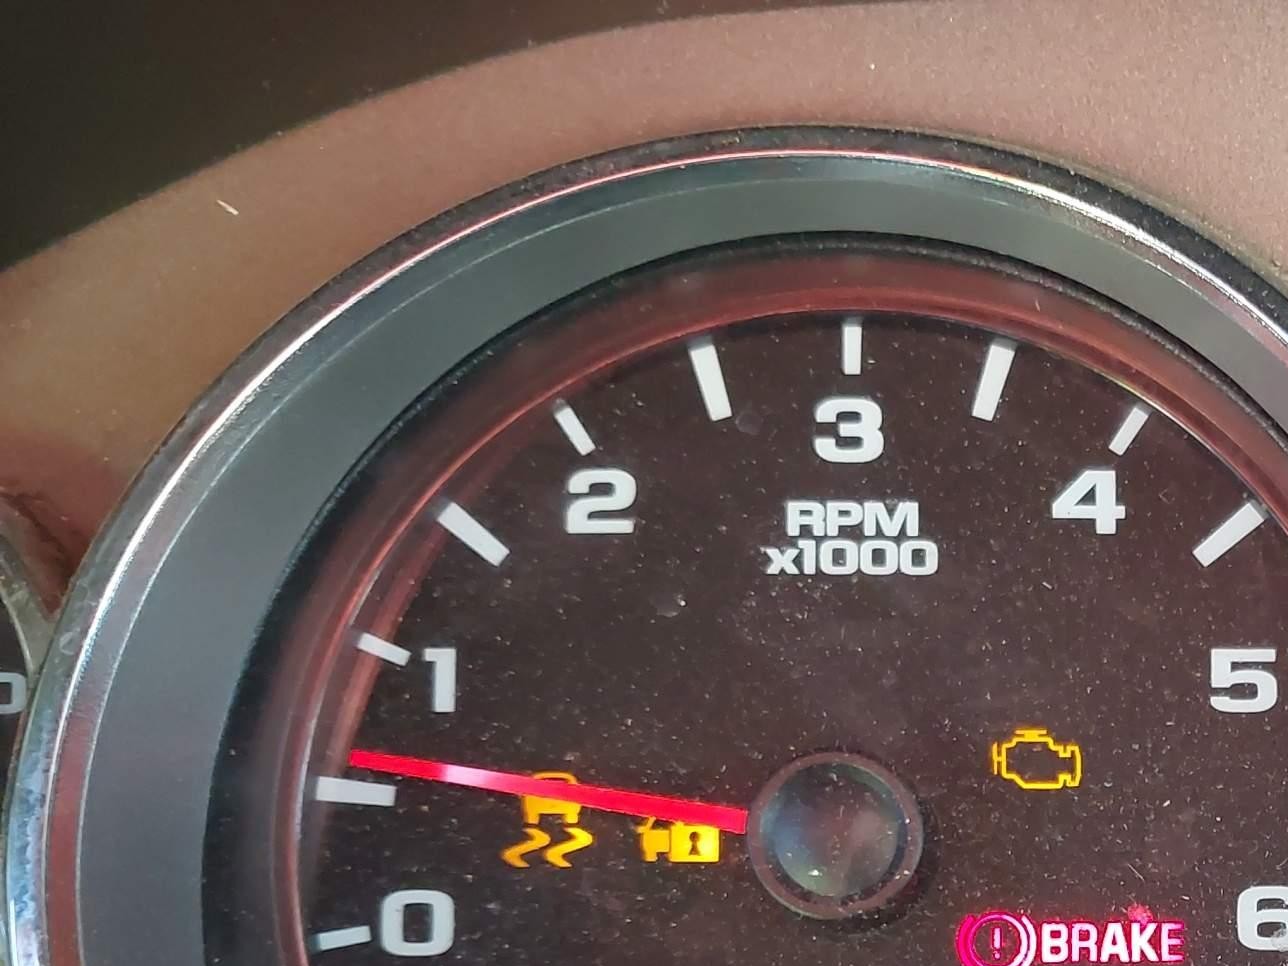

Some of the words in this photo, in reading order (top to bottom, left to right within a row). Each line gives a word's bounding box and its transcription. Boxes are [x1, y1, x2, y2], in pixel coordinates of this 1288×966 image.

[814, 398, 885, 464] 3
[565, 468, 638, 535] 2
[785, 501, 920, 537] RPM
[1051, 470, 1127, 535] 4
[761, 539, 939, 576] x1000
[423, 647, 457, 714] 1
[1210, 647, 1279, 714] 5
[380, 888, 456, 958] 0
[1040, 920, 1186, 965] BRAKE
